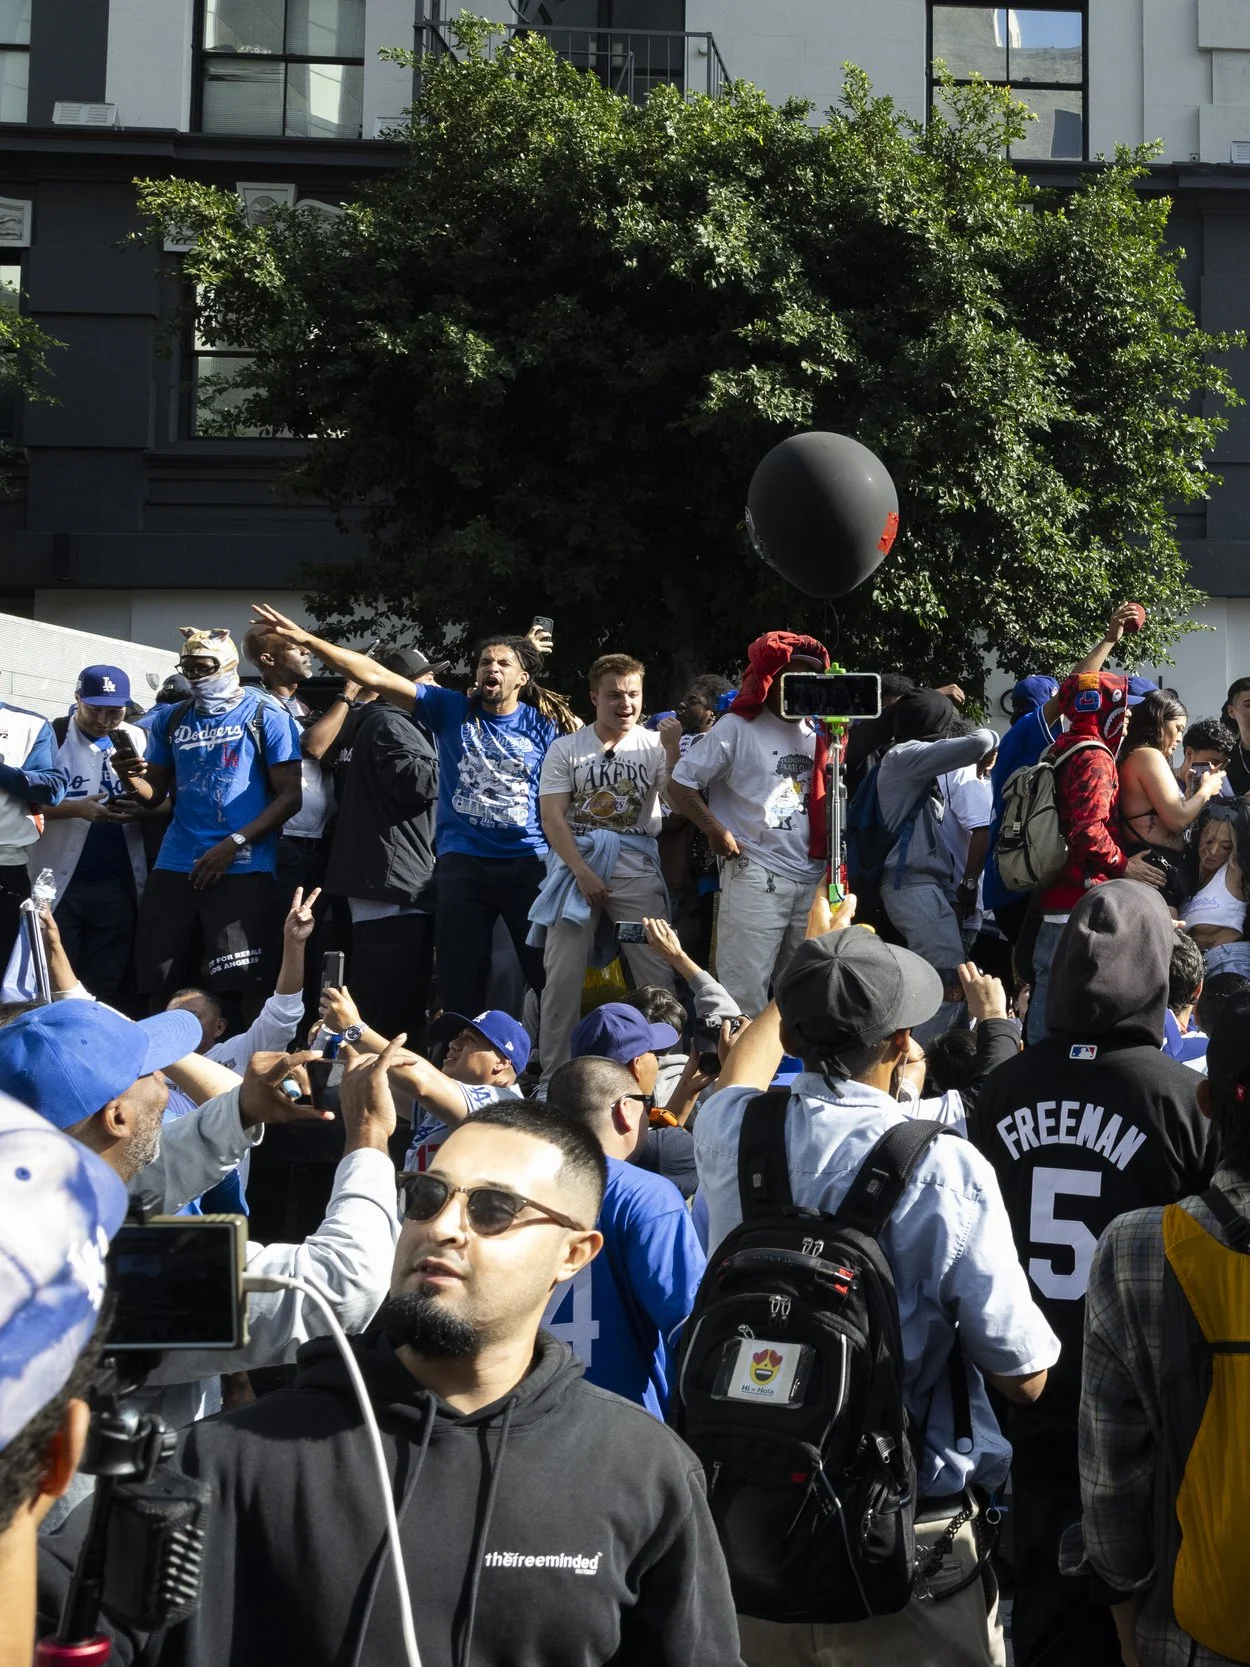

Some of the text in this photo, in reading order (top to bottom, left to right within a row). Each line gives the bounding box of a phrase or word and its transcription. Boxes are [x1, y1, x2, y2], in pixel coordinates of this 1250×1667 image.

[102, 676, 116, 693] LA
[174, 724, 245, 750] Dodgers
[573, 761, 651, 801] LAKERS
[216, 954, 234, 964] FOR
[996, 1100, 1147, 1171] FREEMAN
[1028, 1166, 1102, 1300] 5
[540, 1260, 600, 1367] 4
[757, 1387, 775, 1395] Hola
[485, 1551, 601, 1570] thefreeminded
